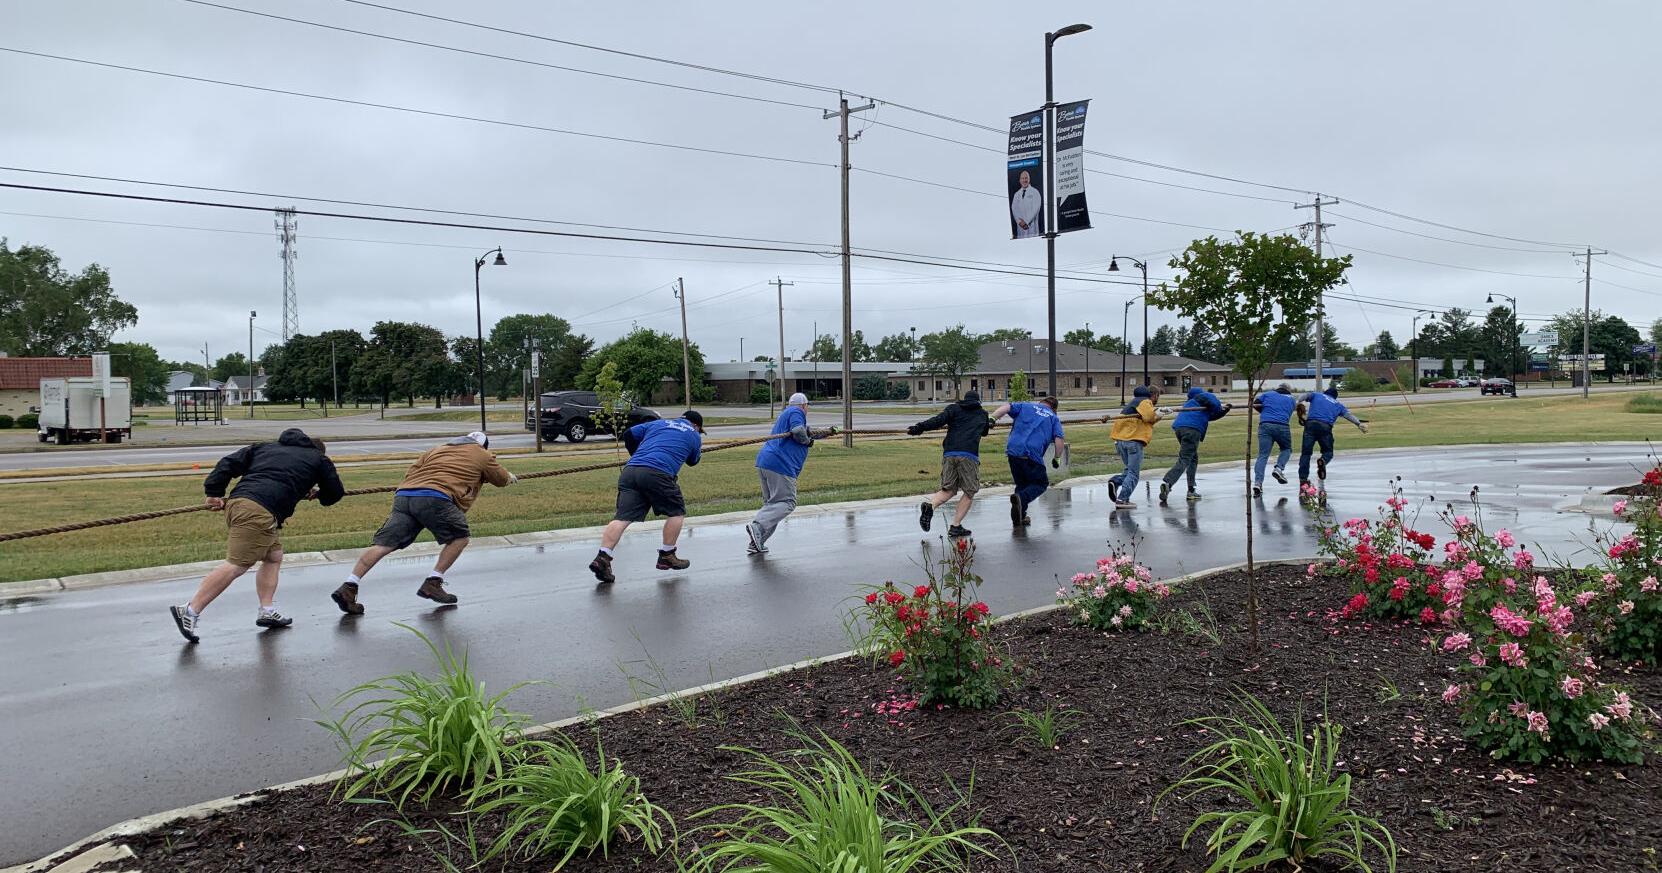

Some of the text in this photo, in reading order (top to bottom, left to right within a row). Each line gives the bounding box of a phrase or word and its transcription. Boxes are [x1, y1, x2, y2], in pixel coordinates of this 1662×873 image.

[1010, 133, 1042, 143] Know your
[1009, 140, 1042, 151] Specialists
